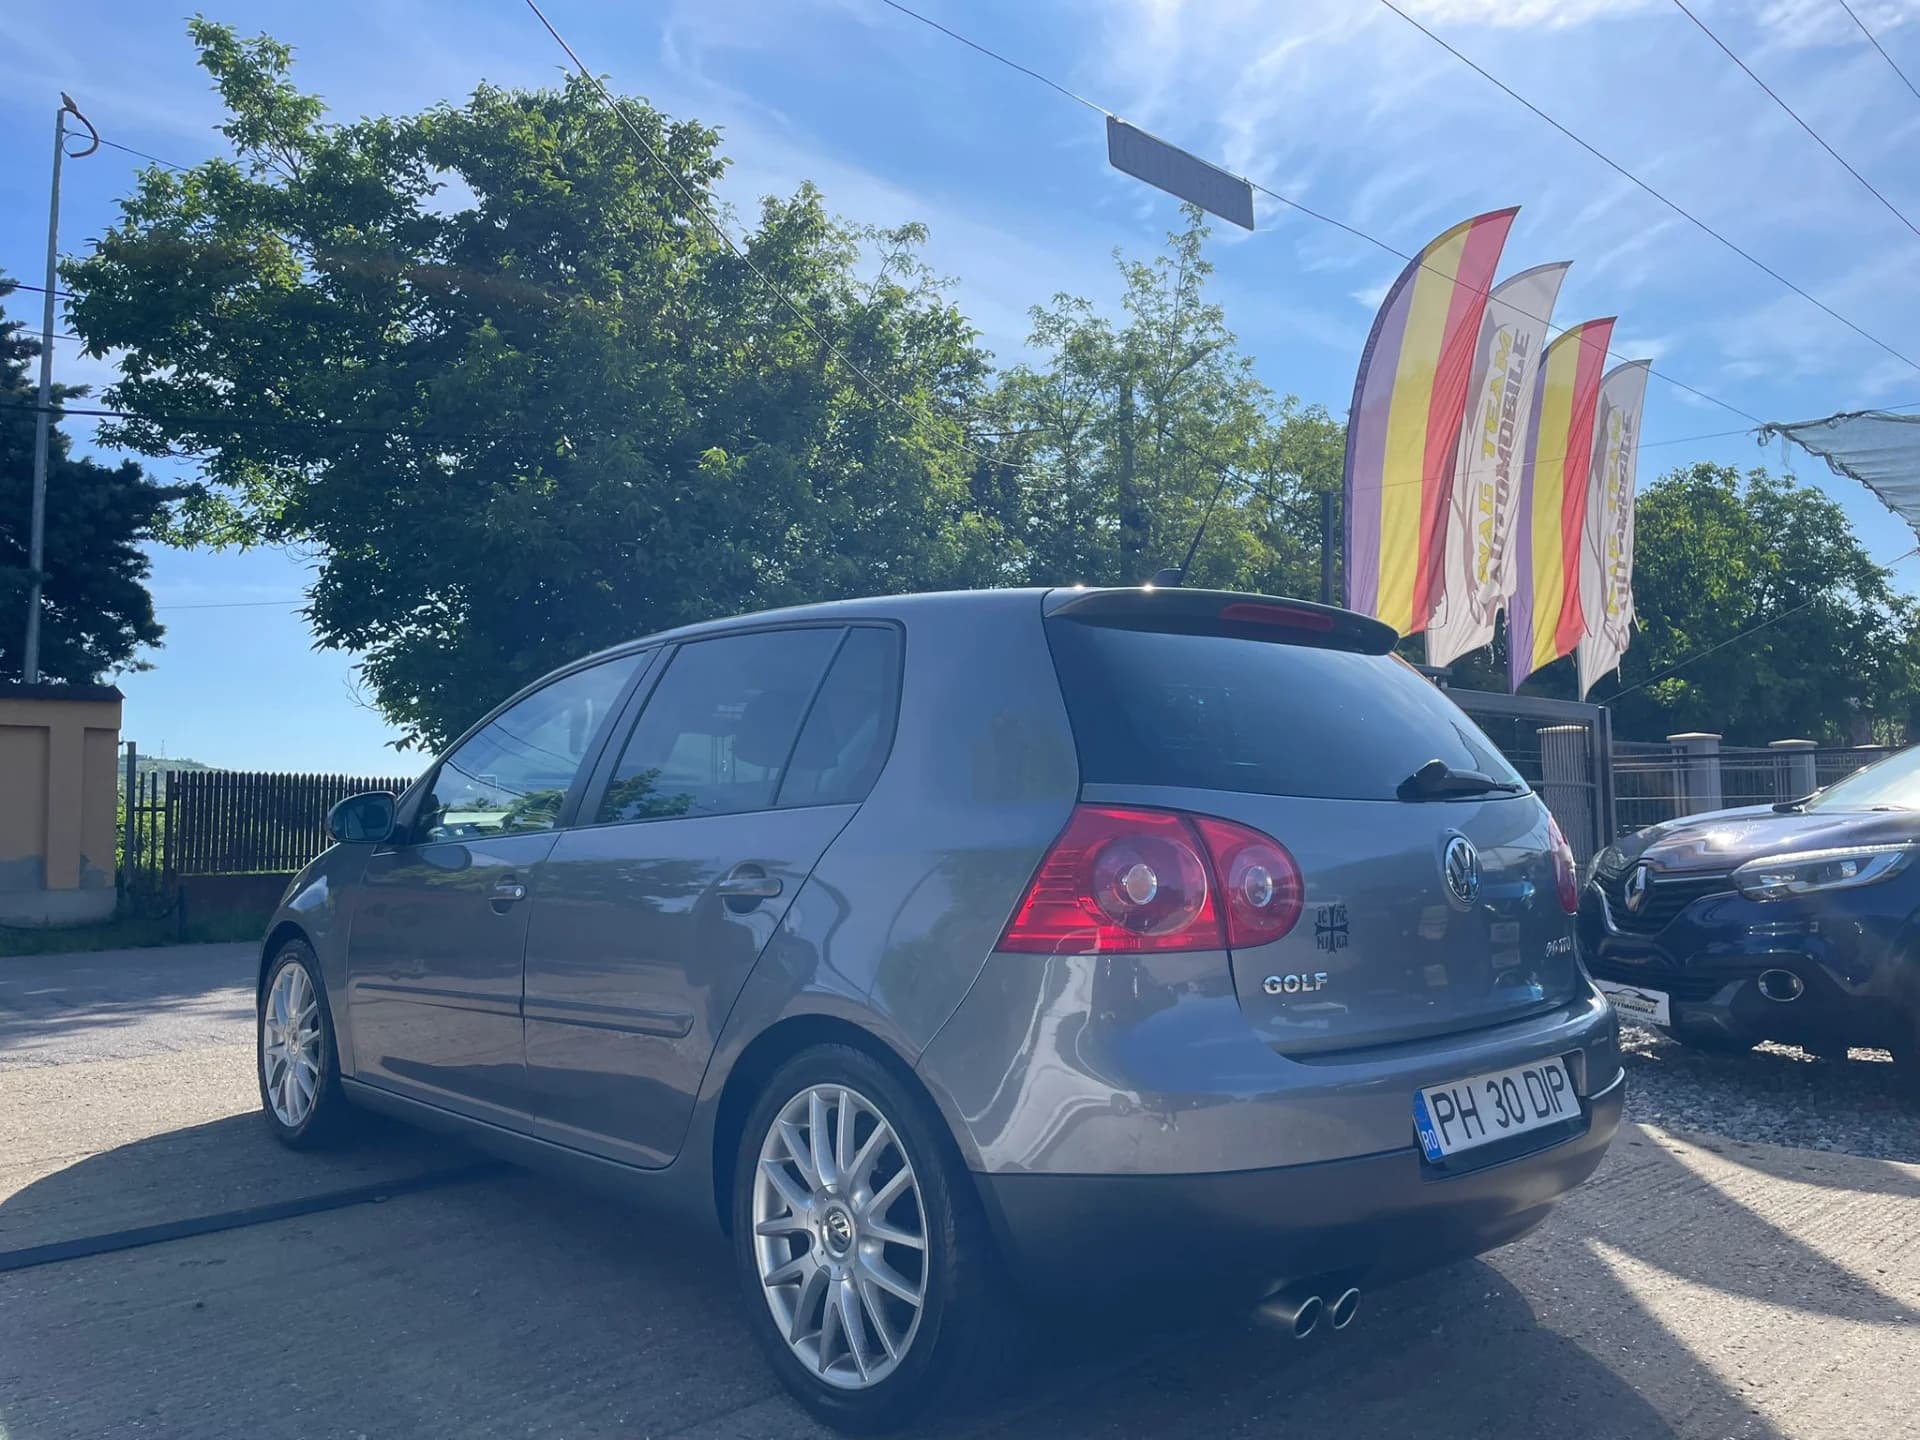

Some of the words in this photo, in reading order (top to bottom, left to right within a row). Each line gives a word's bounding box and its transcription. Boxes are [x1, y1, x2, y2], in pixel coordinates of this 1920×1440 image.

[1481, 329, 1513, 461] TEAM
[1490, 328, 1531, 586] AUTOMOBILE
[1263, 972, 1328, 994] GOLF
[1421, 1129, 1439, 1151] RO
[1430, 1085, 1486, 1147] PH
[1486, 1076, 1526, 1129] 30
[1522, 1064, 1565, 1119] DIP
